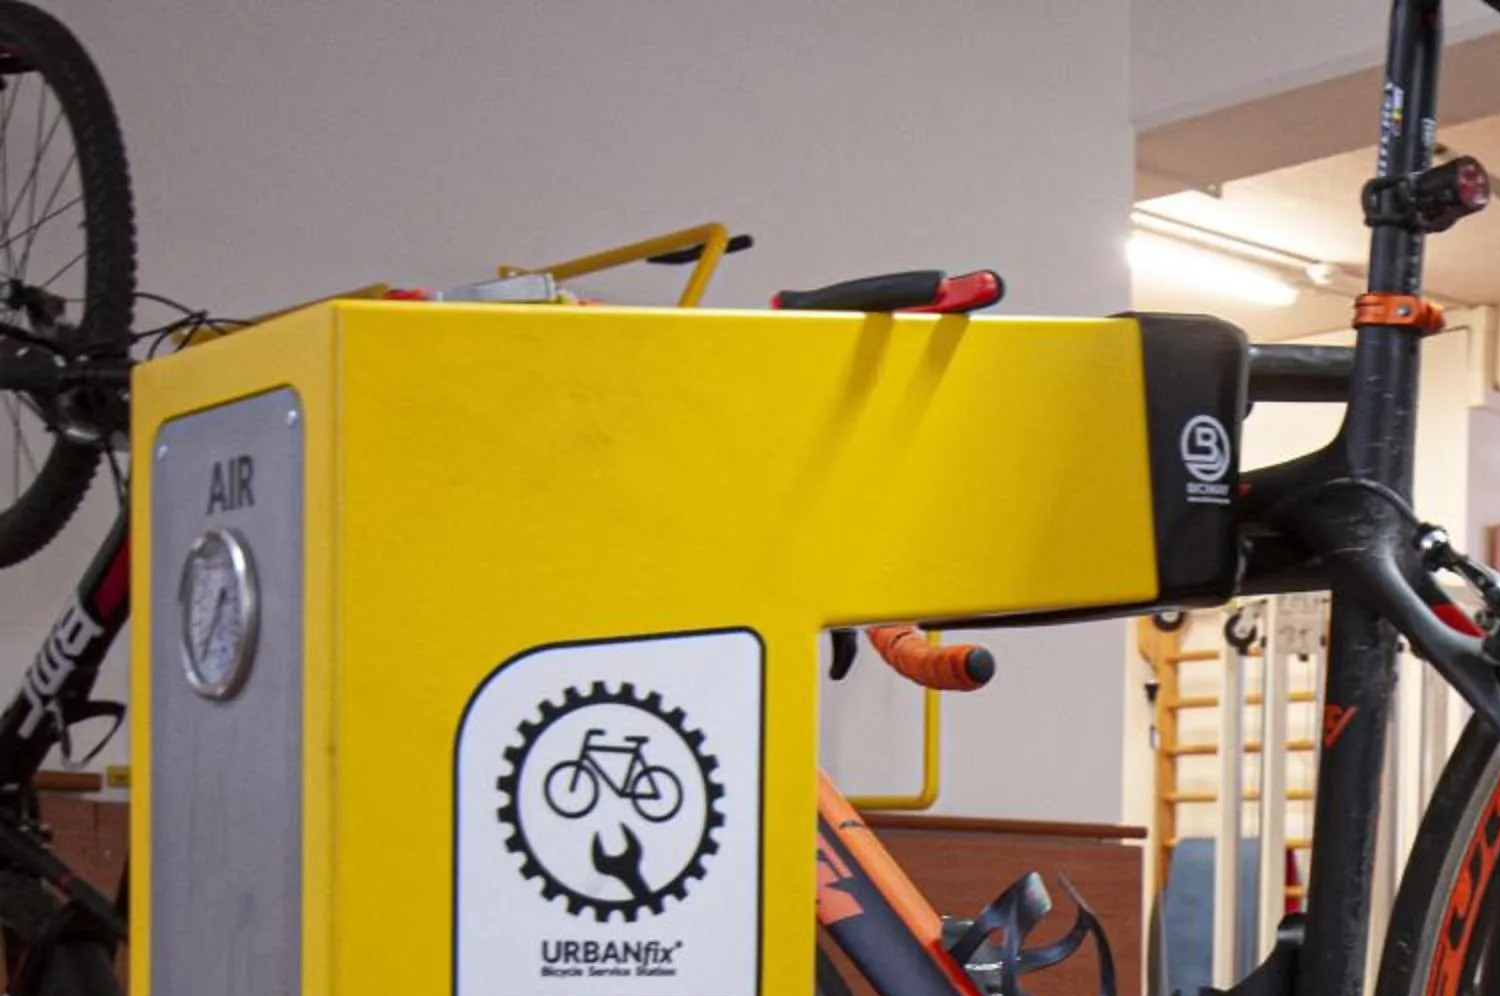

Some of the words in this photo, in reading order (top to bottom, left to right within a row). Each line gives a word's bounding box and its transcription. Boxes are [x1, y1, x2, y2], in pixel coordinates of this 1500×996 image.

[207, 454, 255, 516] AIR
[541, 966, 583, 979] Bicycle
[588, 966, 631, 978] Service
[636, 965, 677, 977] Station
